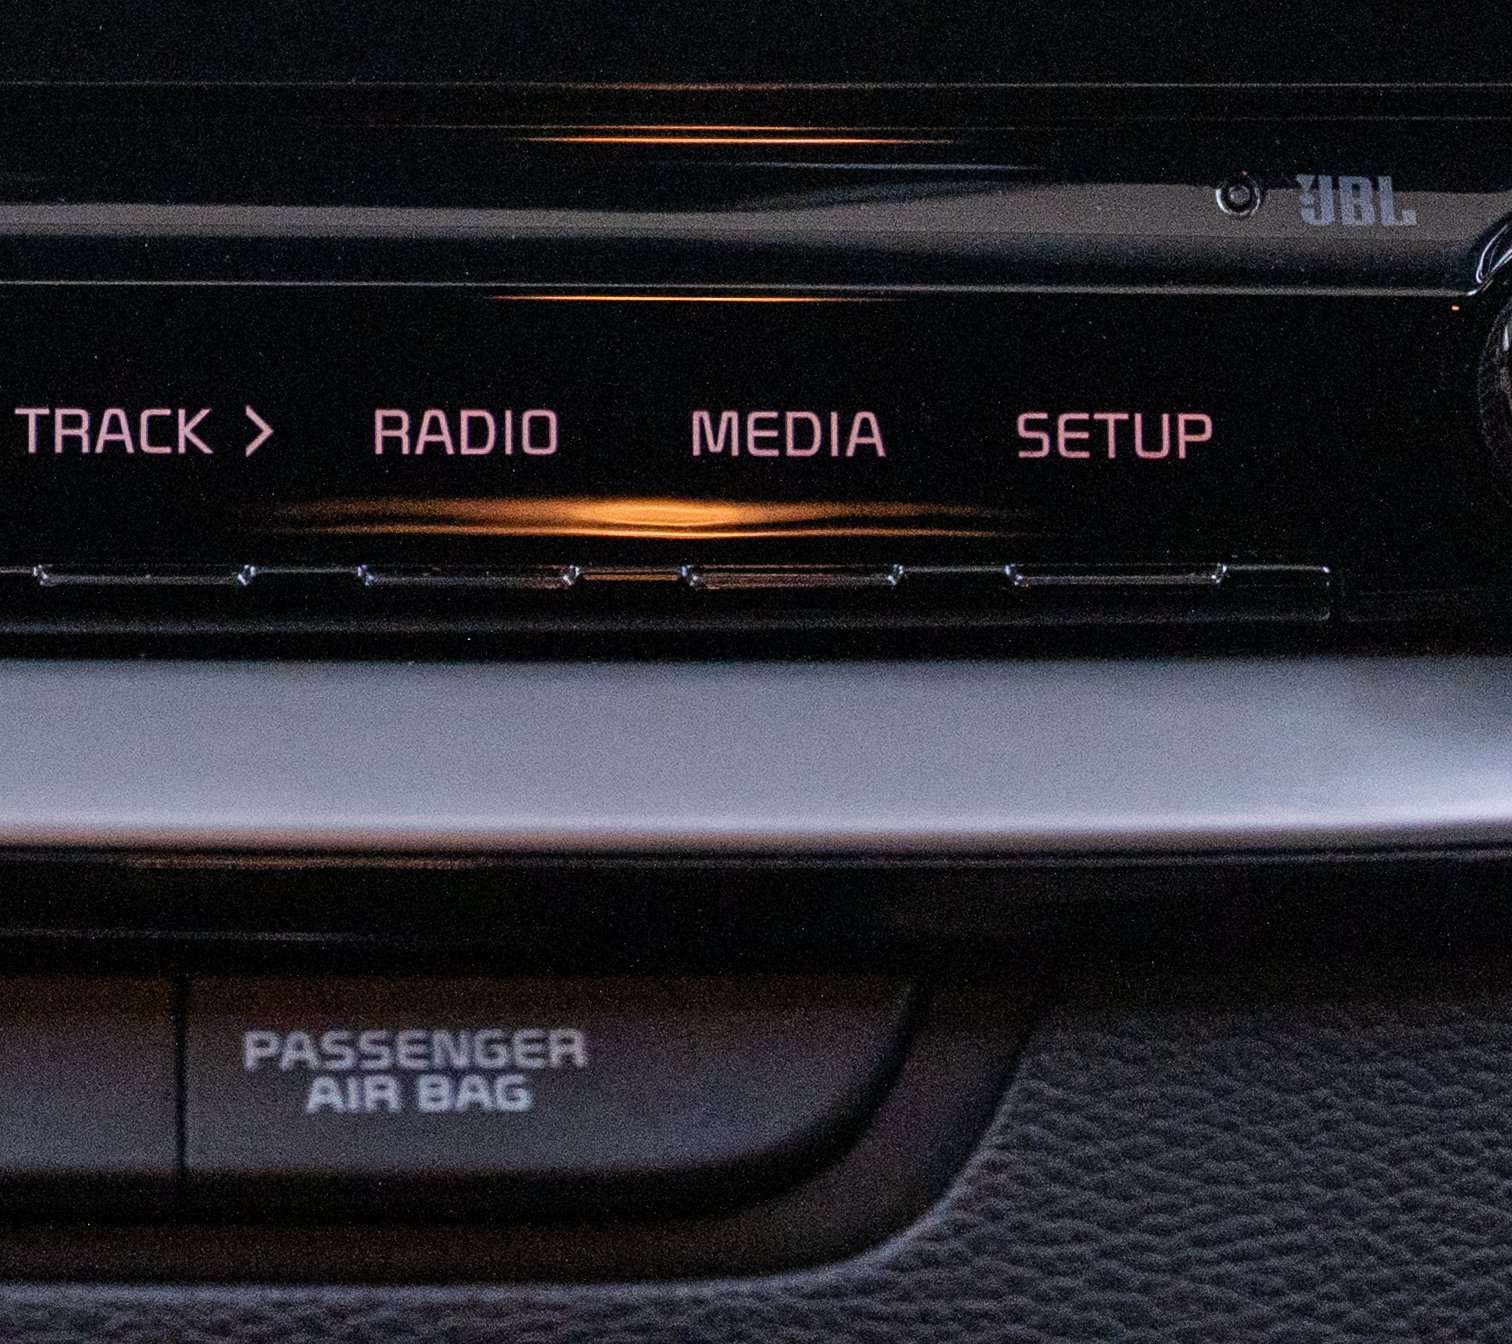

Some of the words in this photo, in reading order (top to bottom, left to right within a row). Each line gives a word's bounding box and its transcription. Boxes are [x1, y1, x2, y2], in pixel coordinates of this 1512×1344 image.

[1296, 174, 1417, 226] JBL
[14, 407, 213, 454] TRACK
[374, 409, 558, 455] RADIO
[692, 410, 885, 457] MEDIA
[1017, 412, 1213, 459] SETUP
[243, 1028, 588, 1071] PASSENGER
[305, 1075, 401, 1113] AIR
[417, 1074, 532, 1113] BAG
